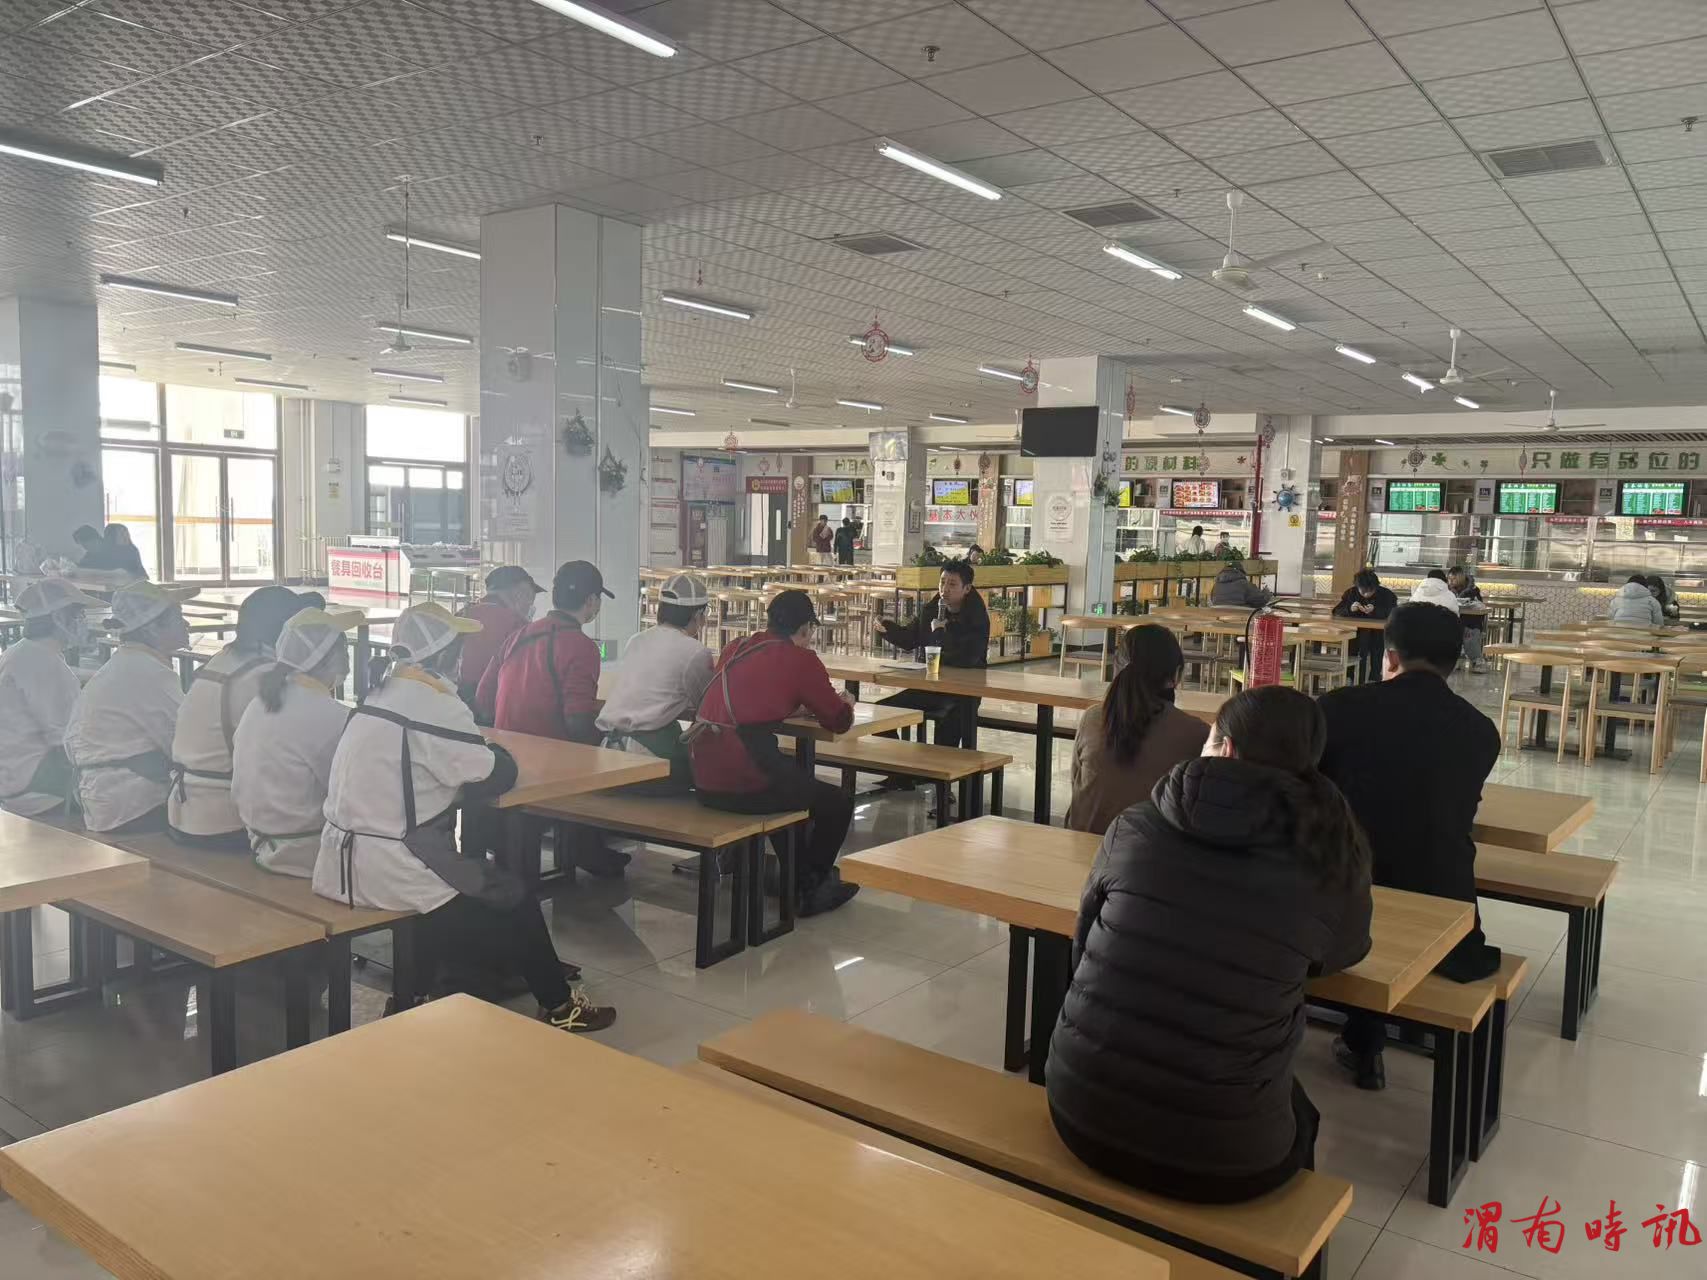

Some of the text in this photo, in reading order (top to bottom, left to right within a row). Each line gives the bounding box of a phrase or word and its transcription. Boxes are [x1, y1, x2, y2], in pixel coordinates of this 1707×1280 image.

[1532, 451, 1700, 470] 只做有品位的
[331, 560, 384, 580] 餐具回收台
